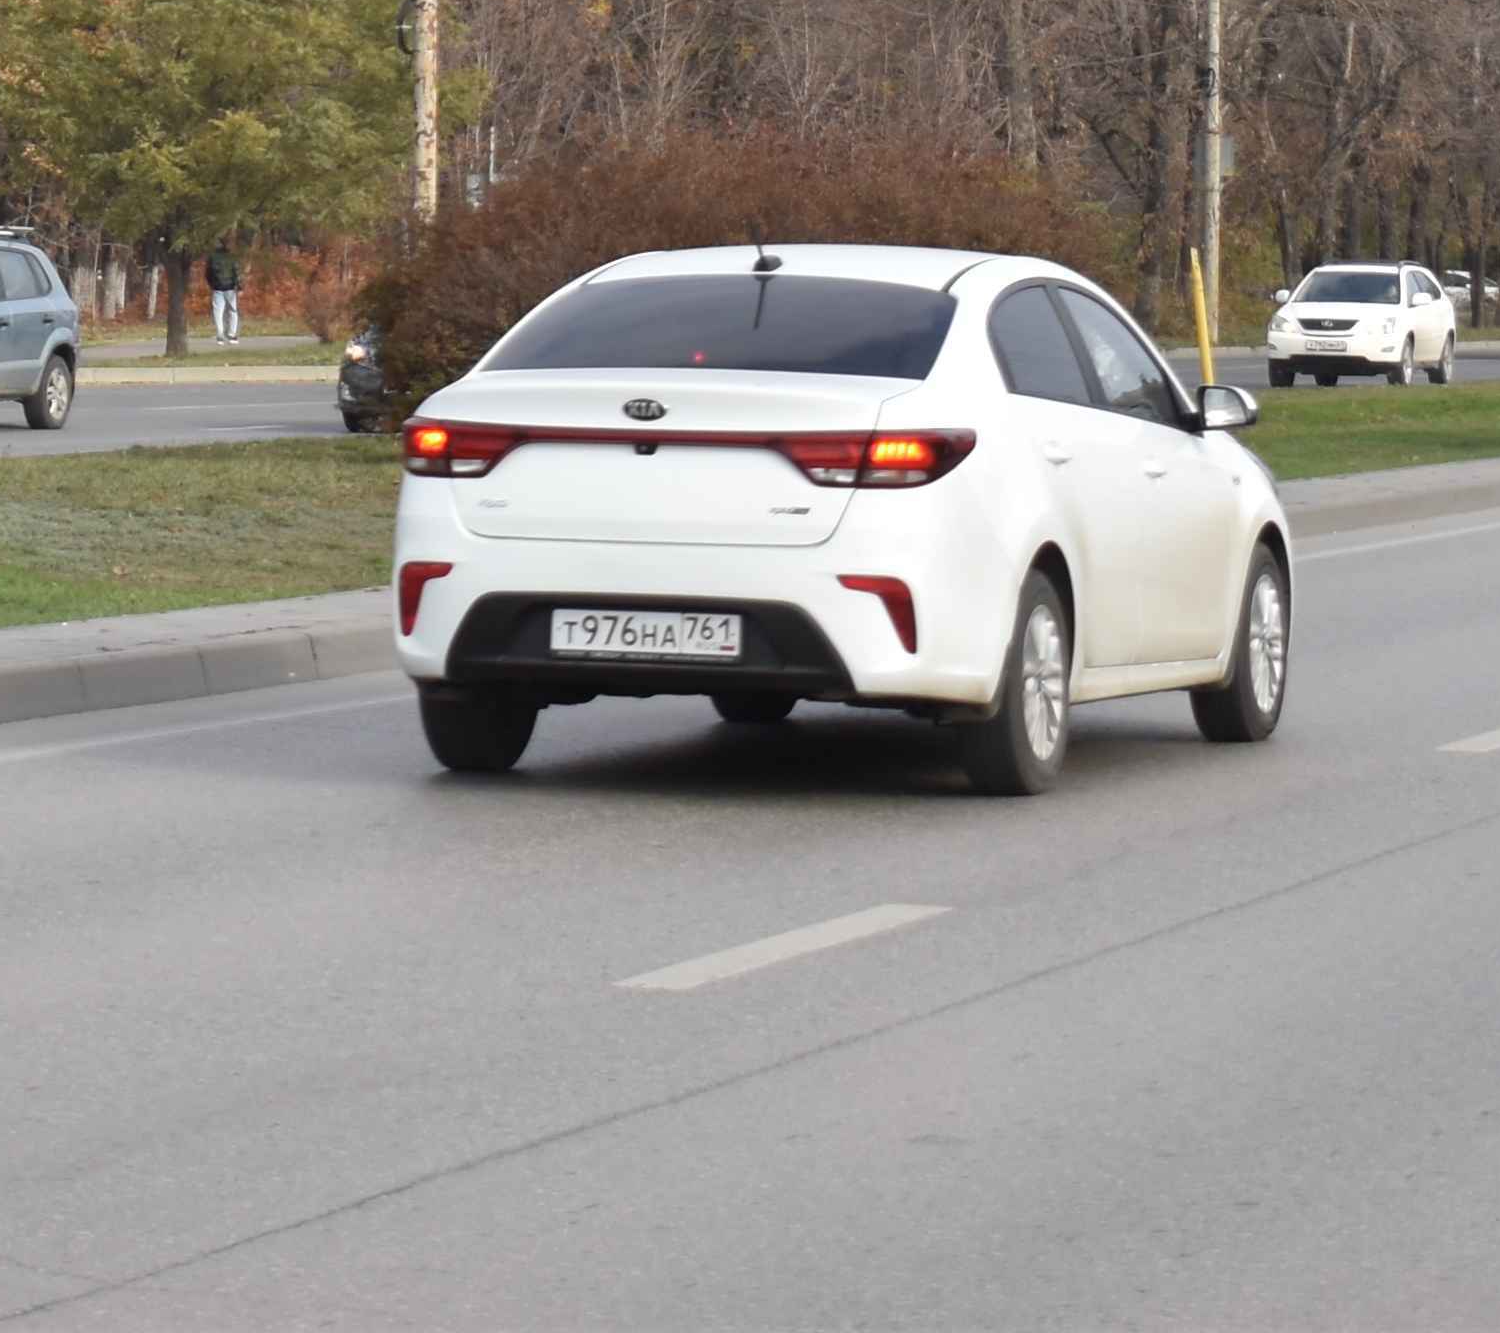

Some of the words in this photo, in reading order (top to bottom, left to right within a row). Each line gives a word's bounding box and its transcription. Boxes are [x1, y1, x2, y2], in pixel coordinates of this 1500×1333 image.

[627, 400, 661, 418] KIA
[562, 614, 678, 648] Т976НА
[685, 615, 732, 642] 761
